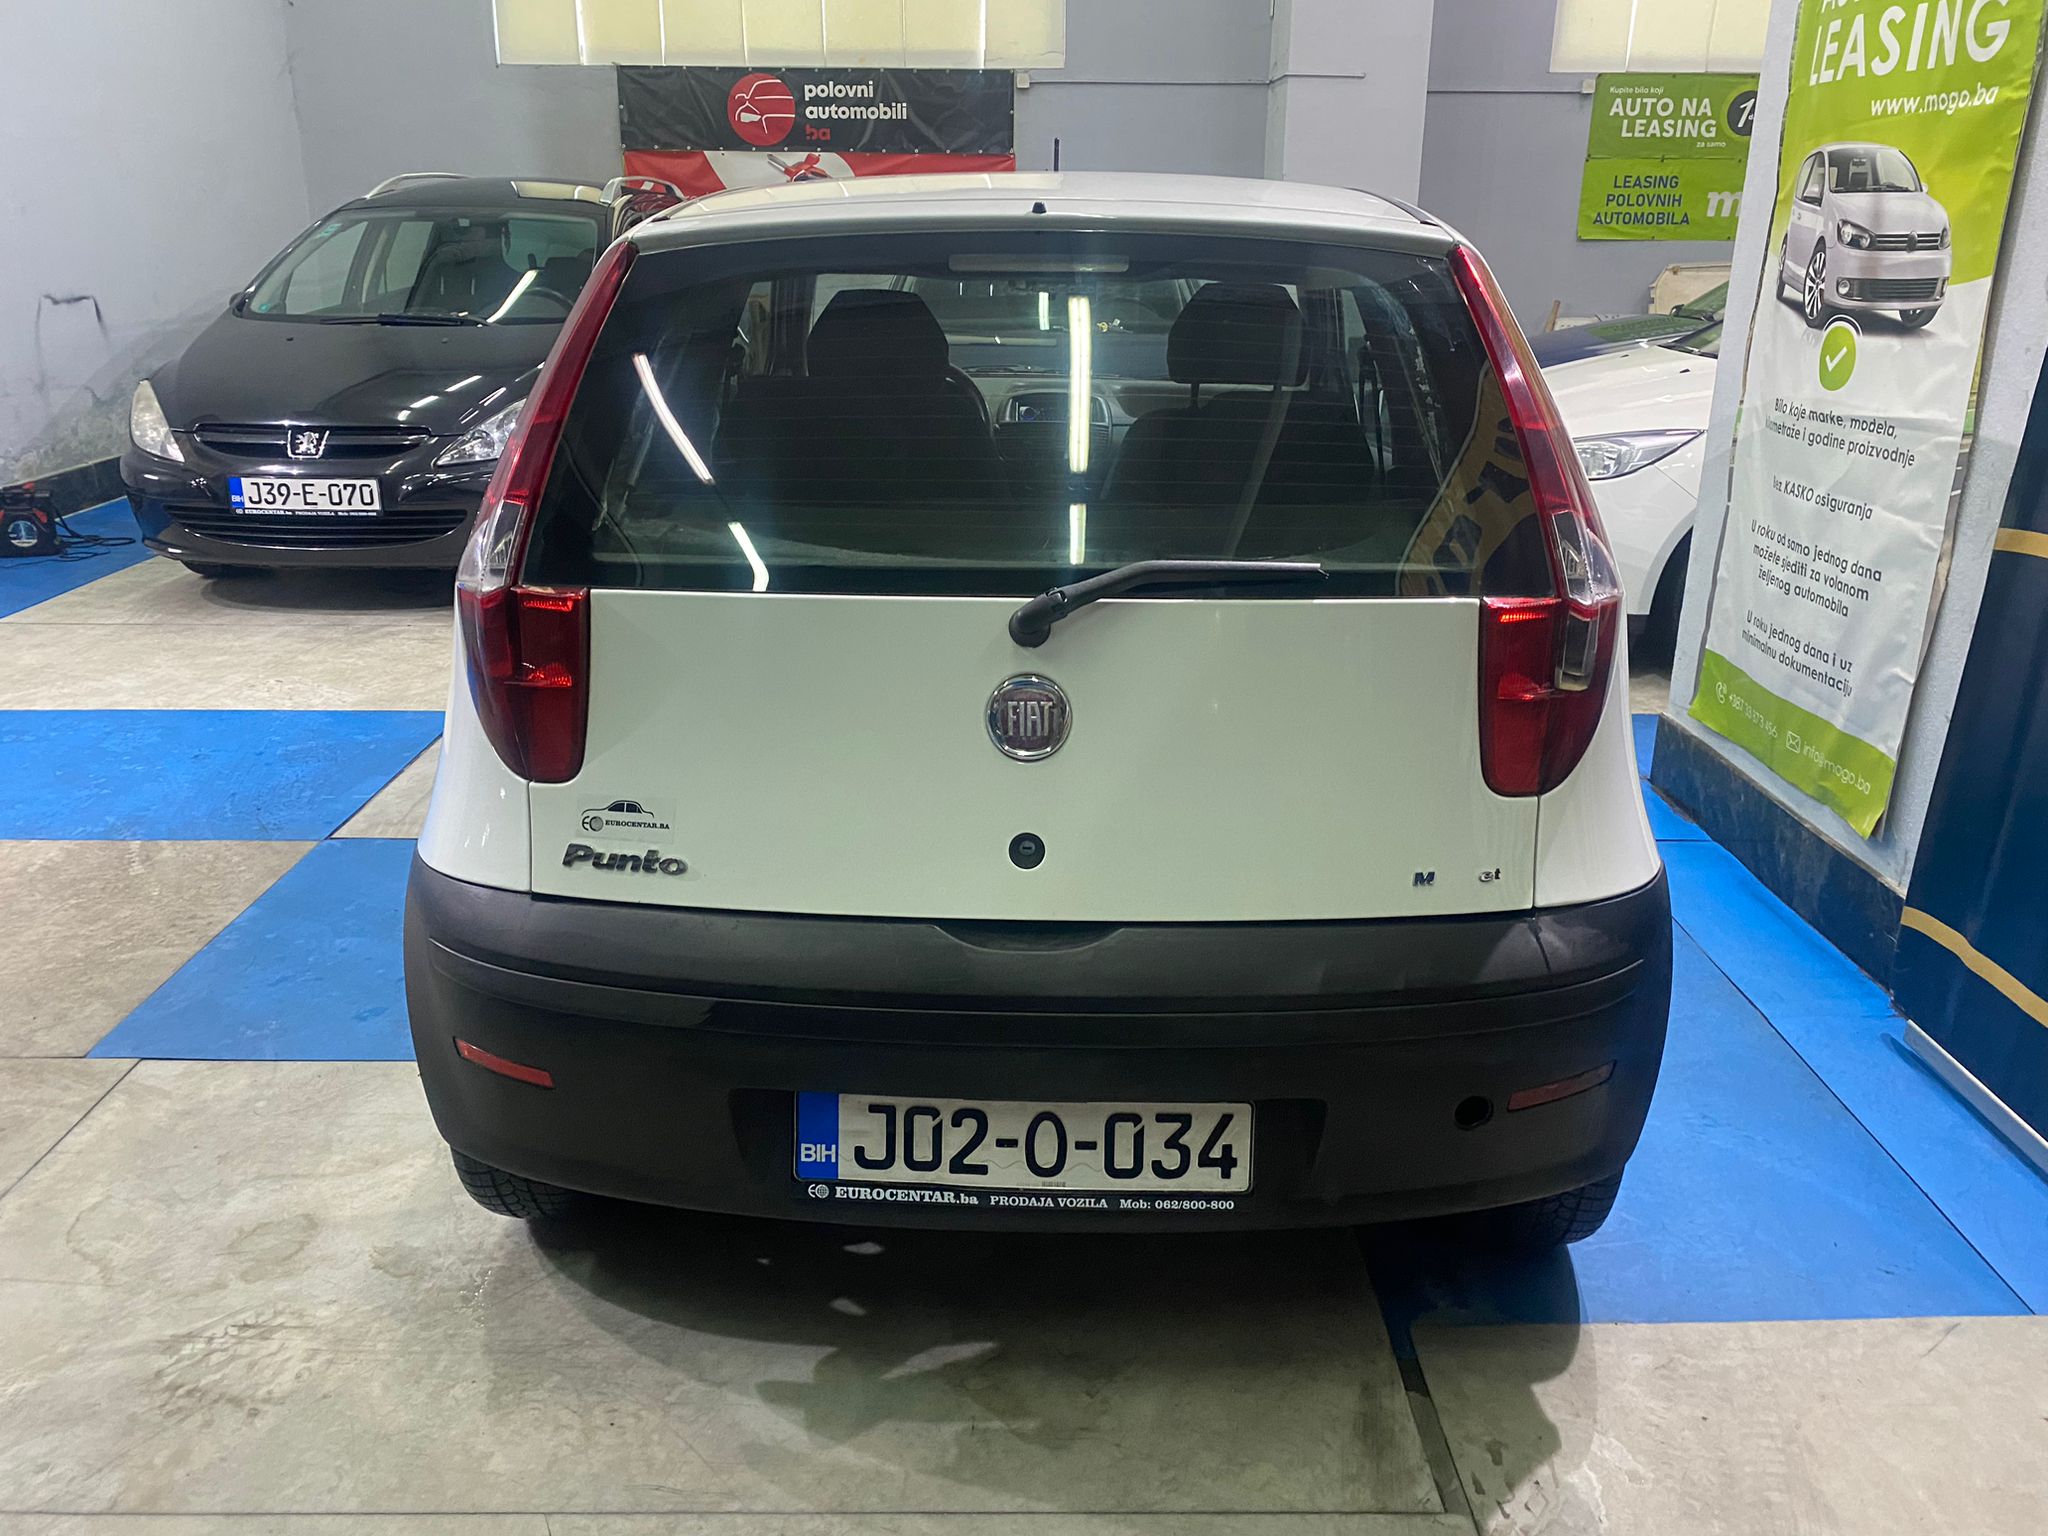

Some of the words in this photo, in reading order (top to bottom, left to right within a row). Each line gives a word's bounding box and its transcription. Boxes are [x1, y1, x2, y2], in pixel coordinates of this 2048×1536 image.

[1809, 0, 2011, 86] LEASING
[804, 81, 873, 101] polovni
[1609, 86, 1633, 94] Kupite
[1650, 86, 1664, 95] koji
[1871, 82, 1999, 117] www.mogo.ba
[805, 102, 907, 119] automobili
[1609, 98, 1674, 117] AUTO
[1681, 98, 1712, 117] NA
[1621, 119, 1717, 138] LEASING
[1613, 175, 1679, 189] LEASING
[1606, 194, 1682, 207] POLOVNIH
[1593, 212, 1690, 225] AUTOMOBILA
[1774, 398, 1788, 414] Bilo
[1789, 402, 1806, 421] koje
[1809, 410, 1846, 429] marke,
[1850, 418, 1897, 440] modela,
[1802, 427, 1806, 441] i
[1808, 432, 1845, 450] godine
[1847, 440, 1915, 469] proizvodnje
[248, 482, 374, 506] J39-E-070
[1783, 480, 1814, 502] KASKO
[1815, 493, 1873, 521] osiguranja
[1751, 519, 1757, 533] U
[1757, 525, 1776, 541] roku
[1777, 533, 1786, 546] od
[1787, 539, 1810, 557] samo
[1812, 545, 1848, 573] jednog
[1851, 560, 1882, 582] dana
[1753, 544, 1780, 565] možete
[1781, 556, 1807, 577] sjediti
[1809, 569, 1820, 583] za
[1824, 574, 1869, 601] volanom
[1758, 564, 1790, 595] željenog
[1794, 585, 1848, 617] automobila
[1741, 629, 1777, 659] minimalnu
[1746, 609, 1753, 623] U
[1753, 616, 1768, 634] roku
[1768, 624, 1801, 653] jednog
[1803, 641, 1829, 663] dana
[1832, 653, 1837, 667] i
[1840, 659, 1853, 673] uz
[1007, 701, 1053, 736] FIAT
[605, 820, 670, 830] EUROCENTAR.BA
[562, 843, 688, 876] Punto
[1412, 871, 1435, 886] M
[800, 1143, 837, 1163] BIH
[835, 1186, 978, 1204] EUROCENTAR.ba
[990, 1196, 1054, 1208] PRODAJA
[1058, 1198, 1108, 1208] VOZILA
[1120, 1199, 1151, 1209] Mob:
[1155, 1200, 1234, 1210] 062/800-800
